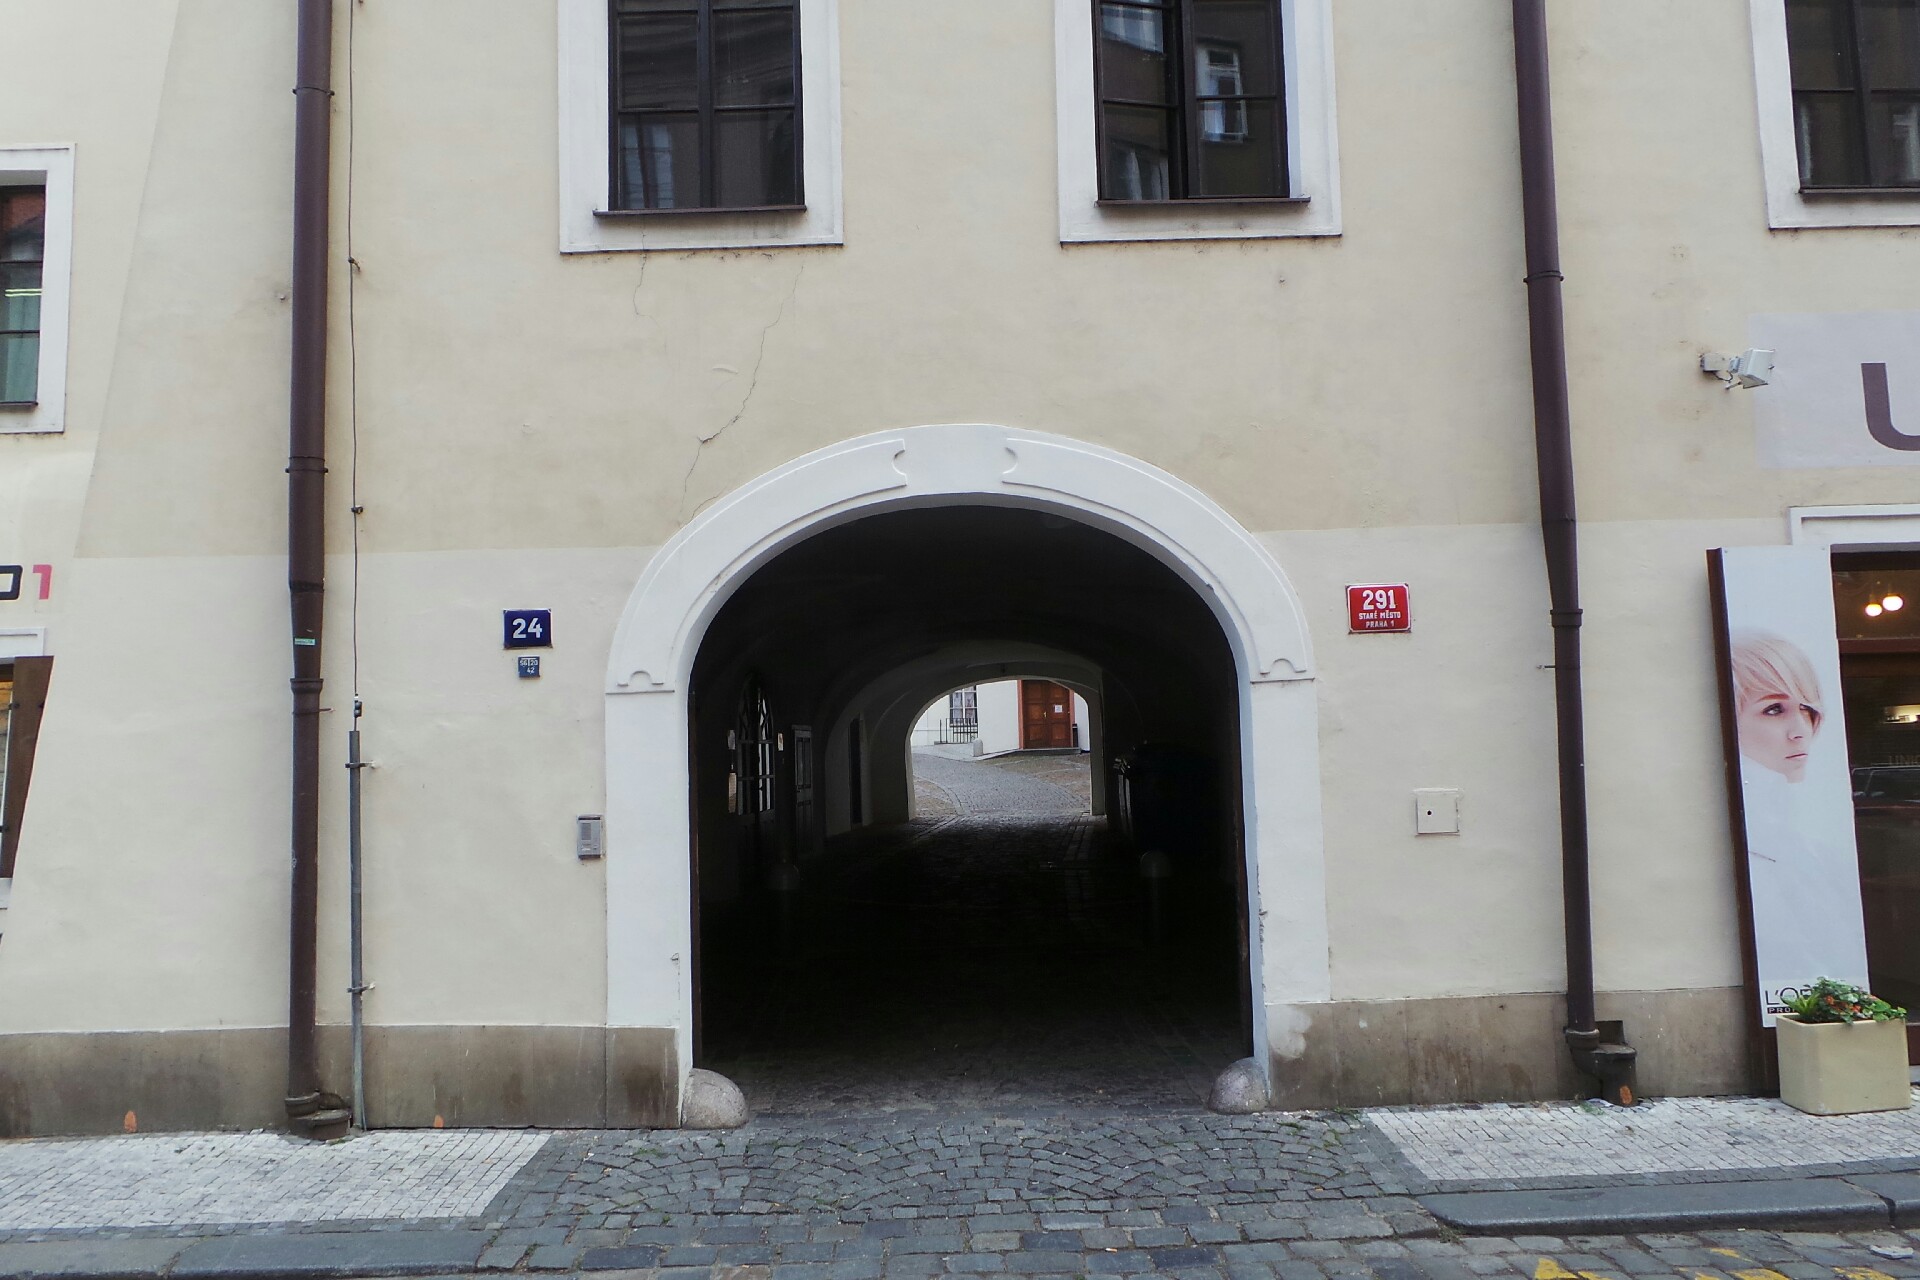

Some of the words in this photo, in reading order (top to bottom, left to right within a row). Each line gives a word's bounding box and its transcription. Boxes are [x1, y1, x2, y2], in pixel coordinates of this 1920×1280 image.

[1362, 589, 1396, 610] 291
[1358, 610, 1378, 619] STARÉ
[1380, 610, 1401, 619] MĚSTO
[512, 617, 543, 639] 24
[1365, 620, 1388, 628] PRAHA
